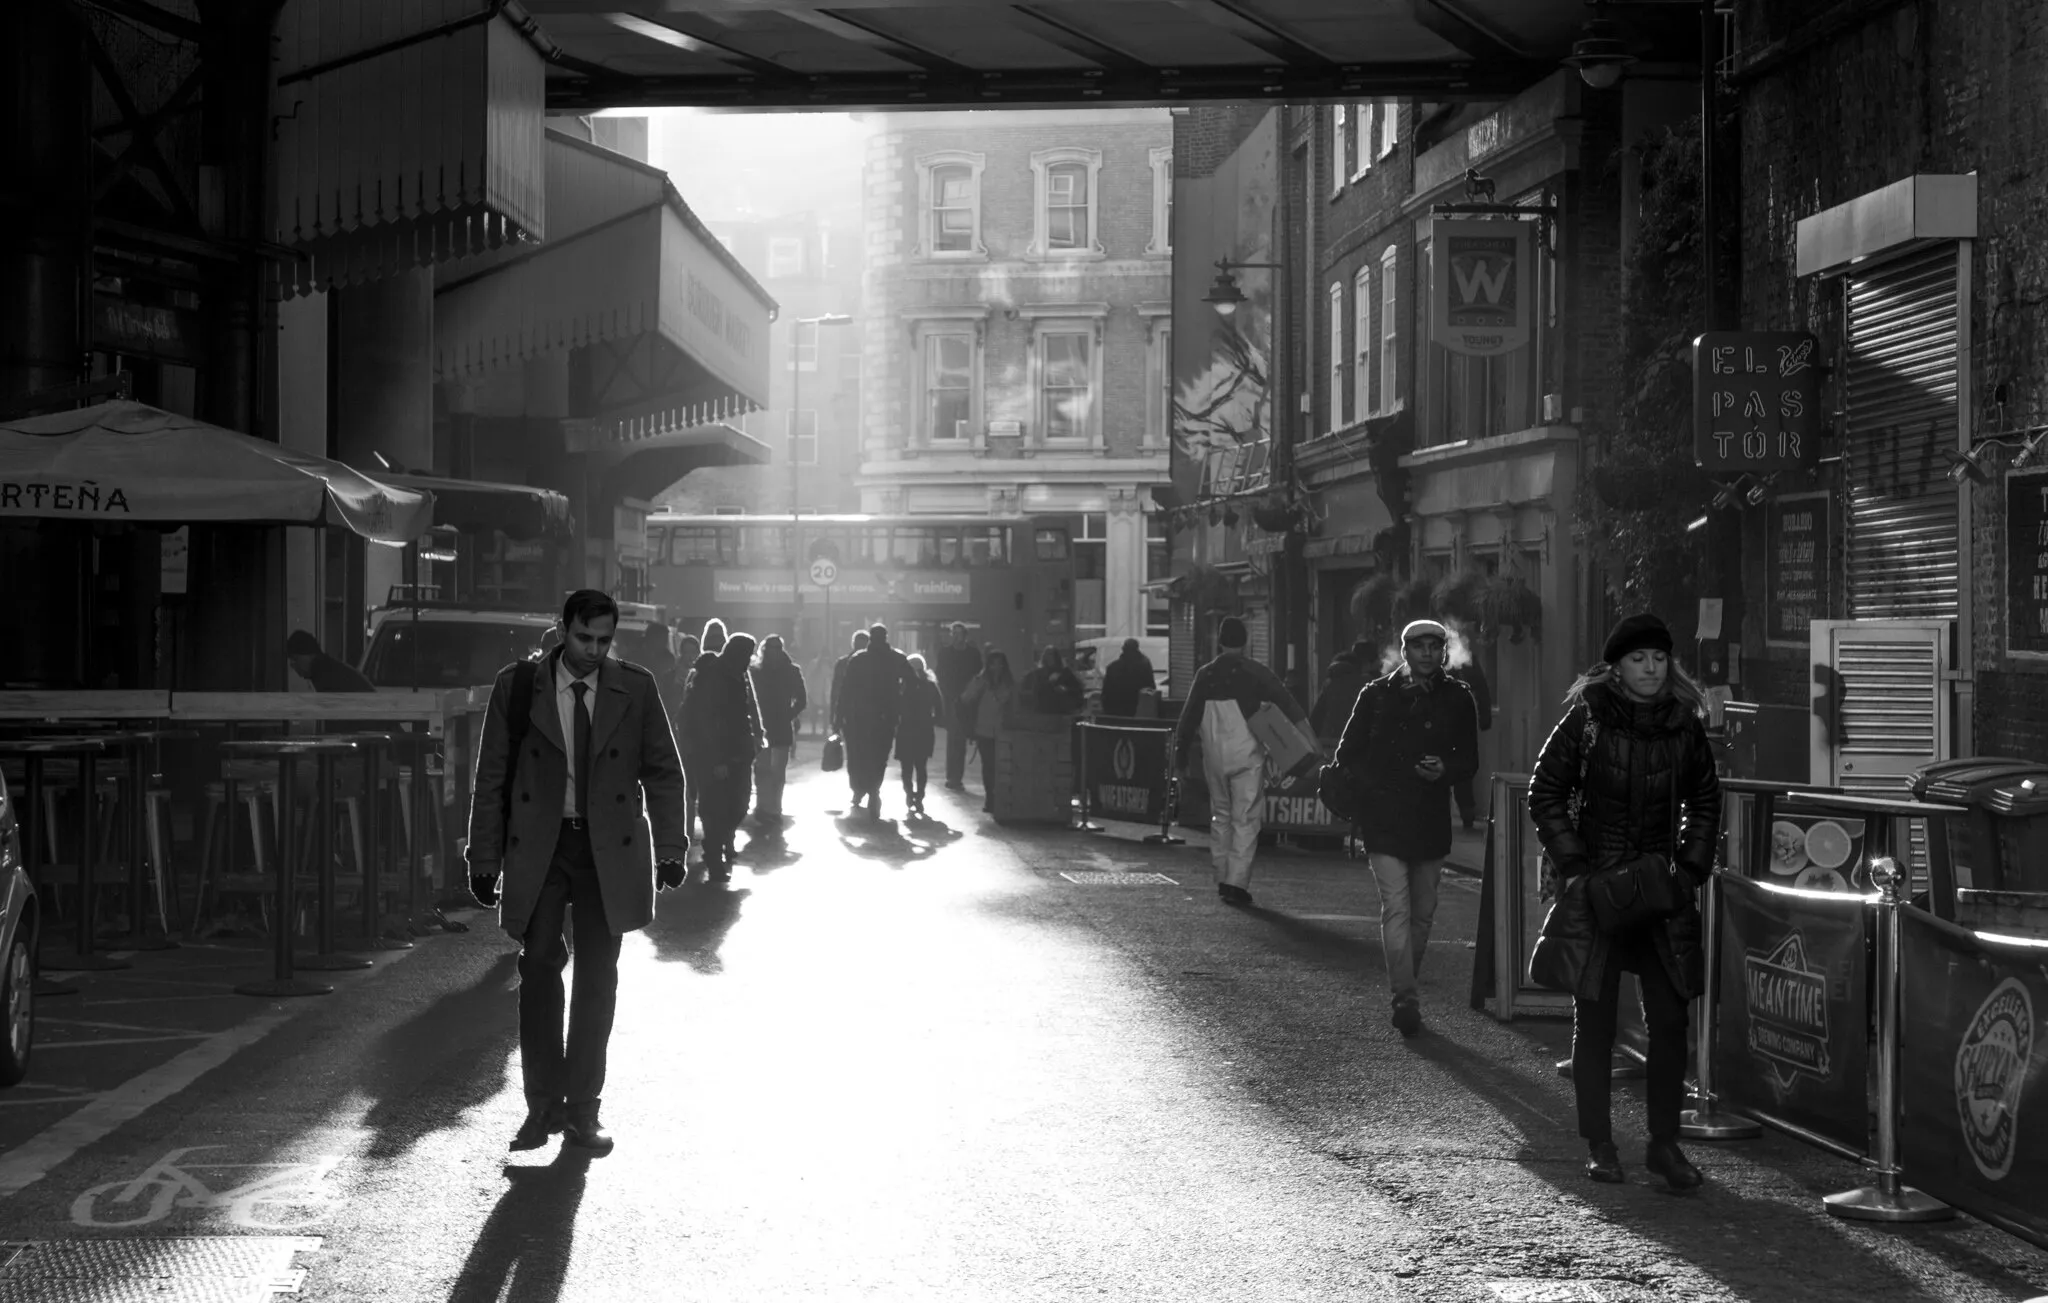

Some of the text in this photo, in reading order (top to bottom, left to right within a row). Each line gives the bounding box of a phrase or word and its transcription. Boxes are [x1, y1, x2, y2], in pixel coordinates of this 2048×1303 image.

[1451, 257, 1513, 304] W
[1712, 346, 1768, 374] EL
[1713, 390, 1803, 418] PAS
[1, 480, 129, 512] RTEÑA
[813, 566, 836, 579] 20
[913, 580, 964, 597] trainline
[1747, 966, 1824, 1027] MEANTIME
